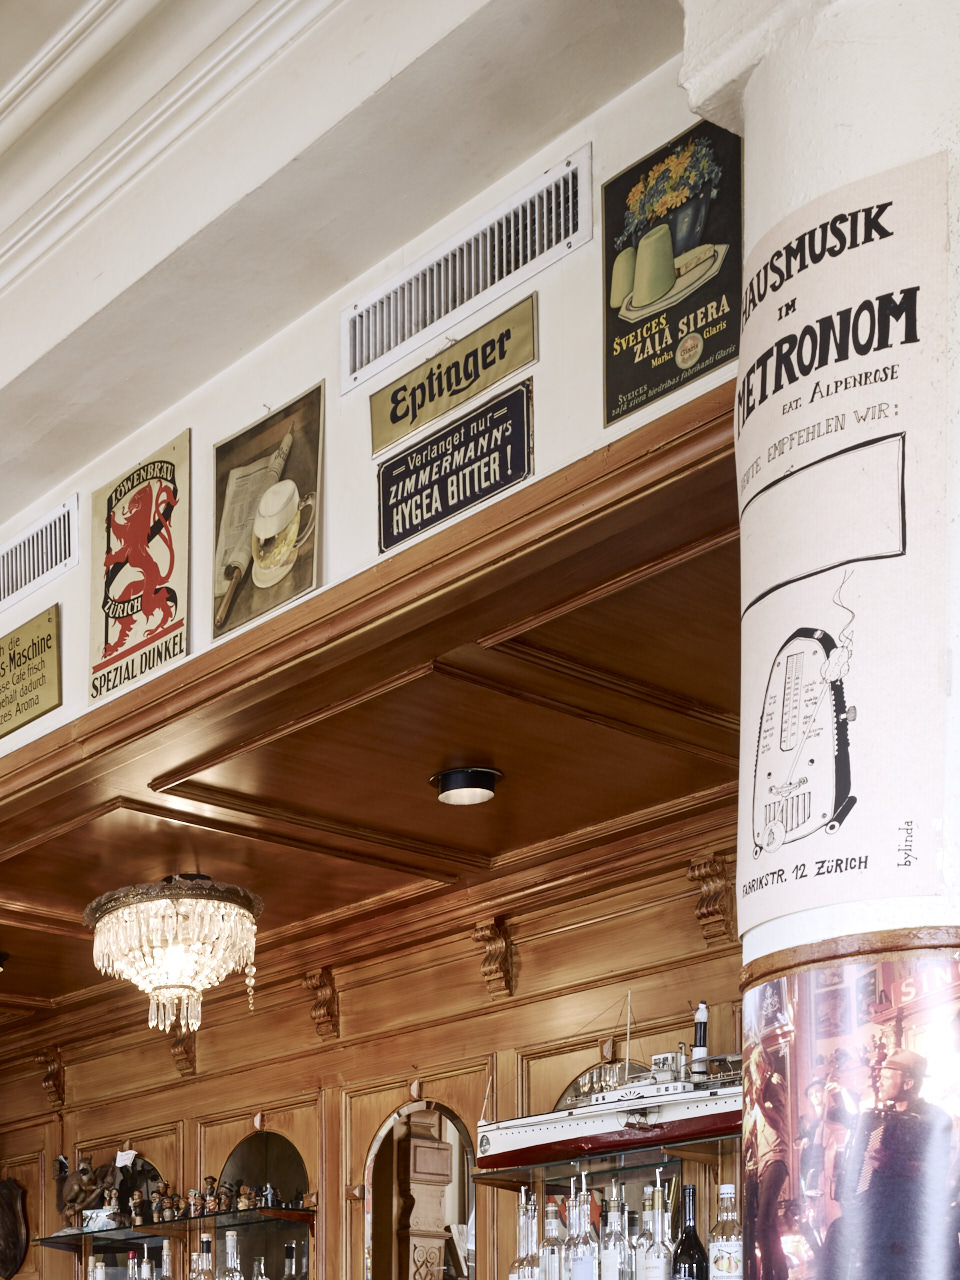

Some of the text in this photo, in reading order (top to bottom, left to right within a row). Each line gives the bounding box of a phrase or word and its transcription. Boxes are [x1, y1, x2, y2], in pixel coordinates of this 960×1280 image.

[741, 201, 894, 336] HAUSMUSIK
[678, 294, 730, 340] SIERA
[777, 298, 797, 321] IM
[651, 320, 727, 368] Marka Glaris
[715, 344, 736, 360] Glaris
[738, 286, 920, 440] METRONOM
[390, 328, 511, 426] Eptinger
[809, 364, 900, 404] ALPENROSE
[407, 413, 492, 470] Verlanget nur
[767, 413, 846, 464] EMPFEHLEN
[110, 463, 175, 507] LÖWENBRÄU
[389, 420, 512, 506] ZIMMERMANN'S
[392, 489, 442, 536] HYGEA
[104, 598, 142, 618] ZÜRICH
[8, 636, 20, 651] die
[91, 631, 184, 699] SPEZIAL DUNKEL
[19, 673, 47, 698] dadurch
[27, 657, 45, 678] frisch
[15, 694, 40, 717] Aroma
[897, 820, 918, 867] bylinda
[792, 863, 808, 880] 12
